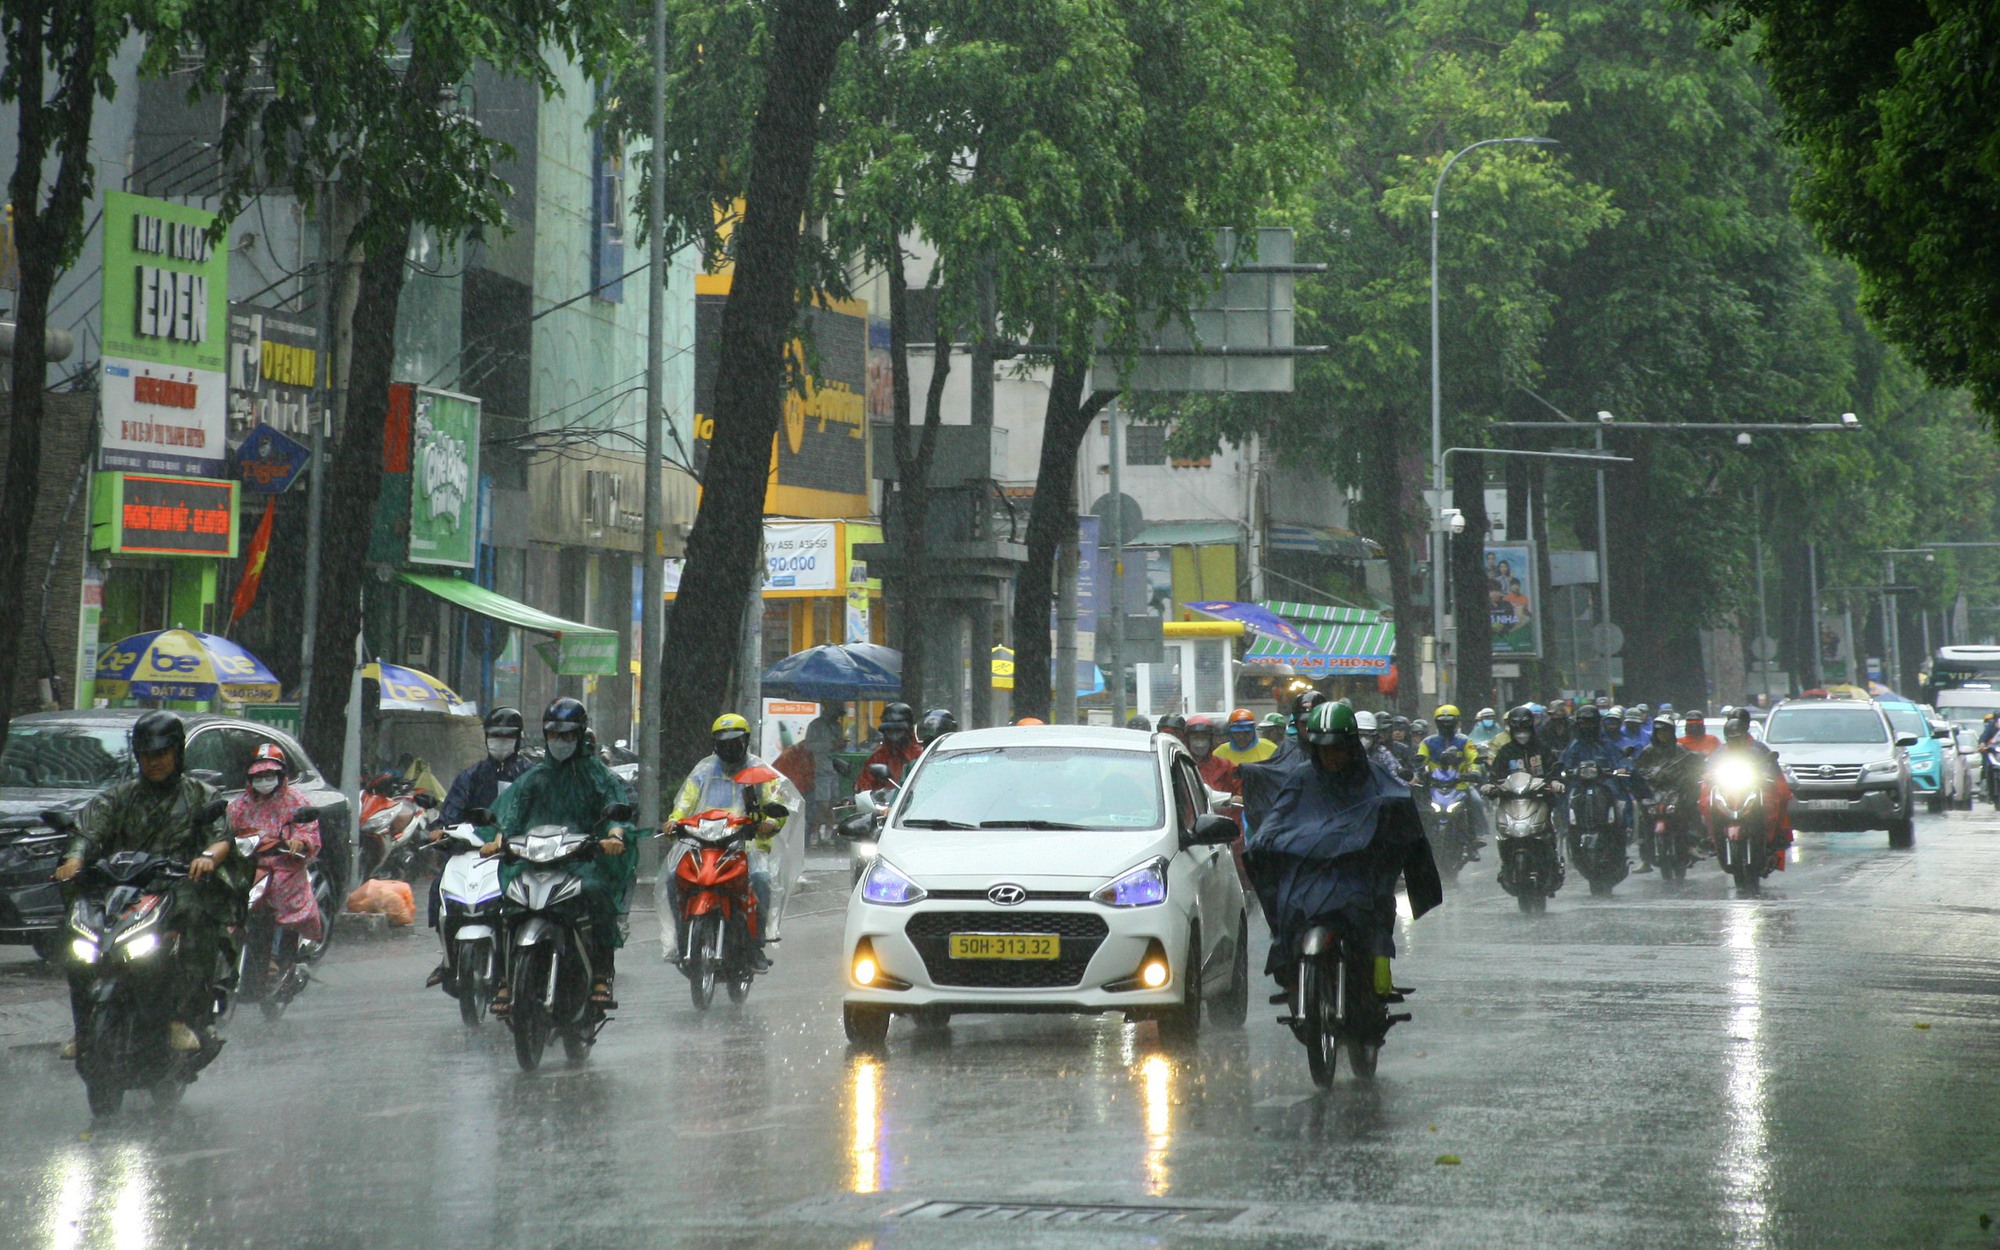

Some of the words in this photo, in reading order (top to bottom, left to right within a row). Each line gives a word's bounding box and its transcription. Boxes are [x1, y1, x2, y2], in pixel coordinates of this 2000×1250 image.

[134, 214, 168, 254] NHA
[138, 266, 208, 343] EDEN
[241, 459, 293, 485] Tiger
[777, 540, 793, 549] A55
[151, 647, 201, 673] be
[209, 648, 257, 675] be
[179, 686, 196, 697] XE
[383, 677, 431, 703] be
[959, 938, 1051, 955] 50H-313.32
